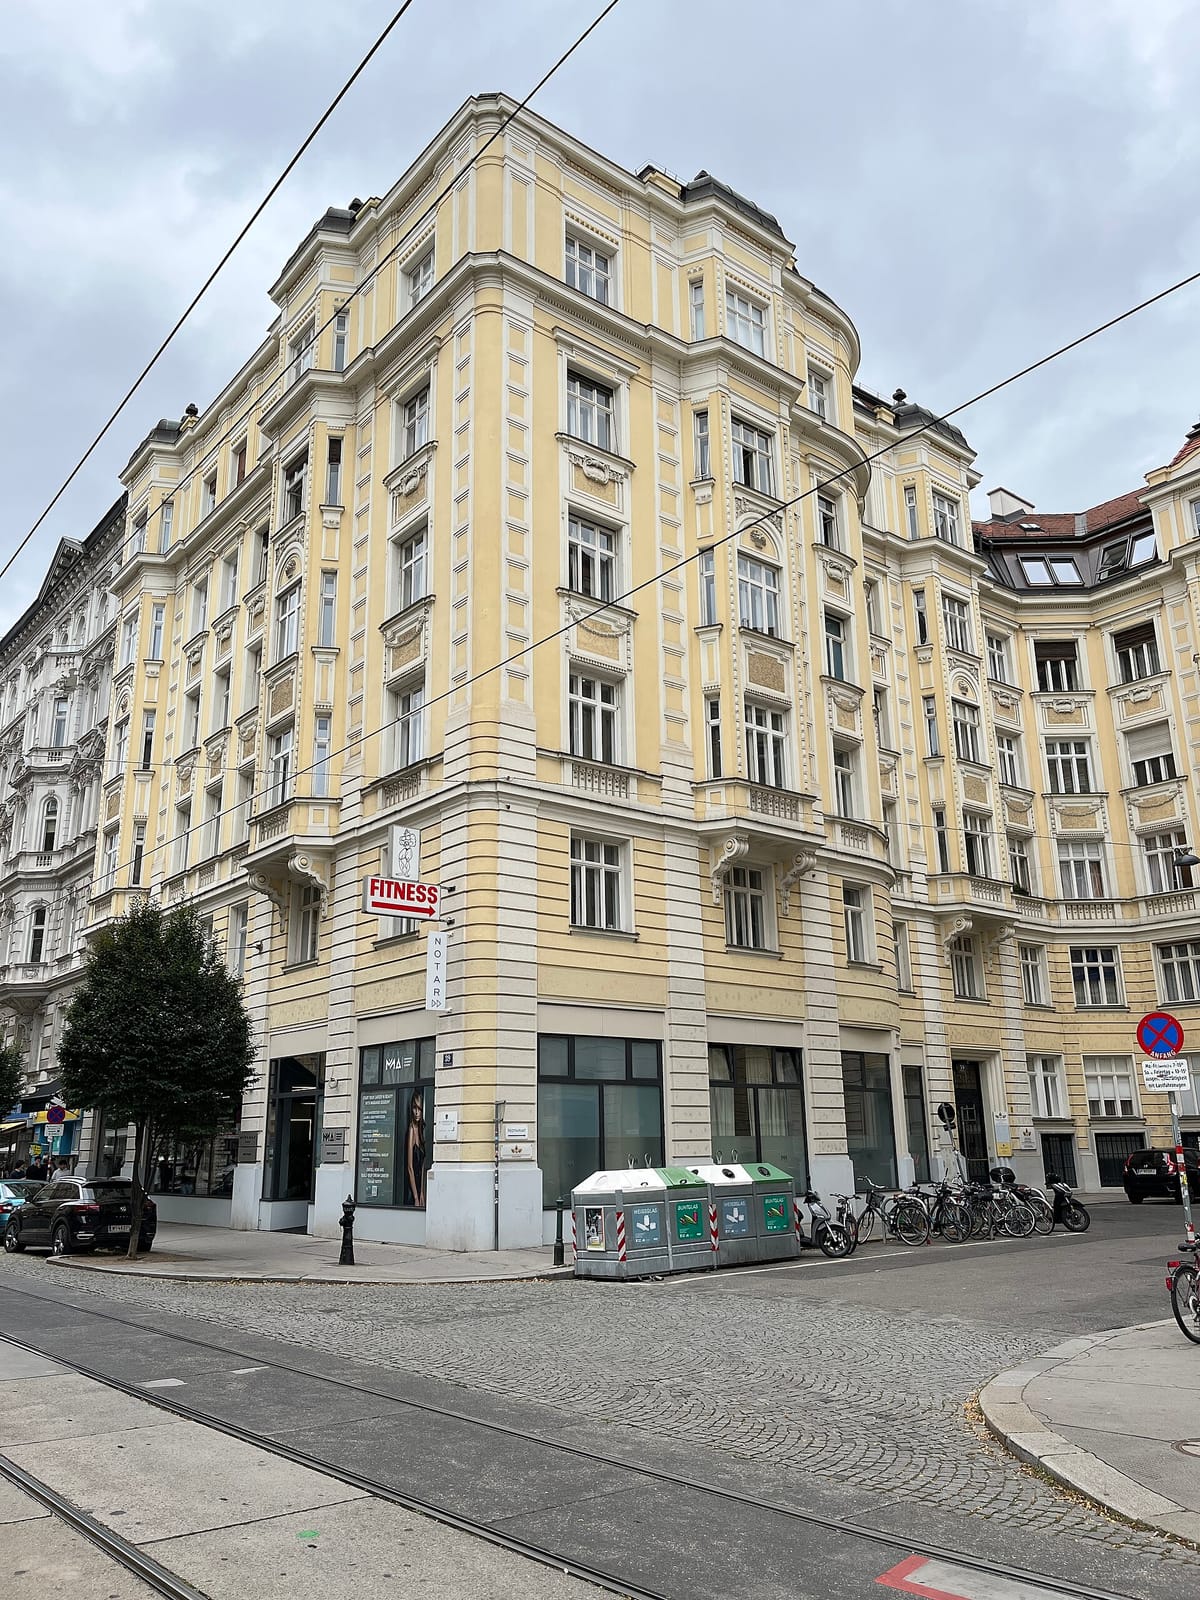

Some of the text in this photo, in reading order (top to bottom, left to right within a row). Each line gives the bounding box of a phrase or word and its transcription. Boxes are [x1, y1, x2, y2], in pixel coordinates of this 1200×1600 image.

[370, 878, 438, 904] FITNESS
[433, 937, 442, 996] NOTAR
[1150, 1050, 1176, 1059] ANFANG
[633, 1207, 658, 1215] WEISSGLAS
[677, 1203, 699, 1211] BUNTGLAS
